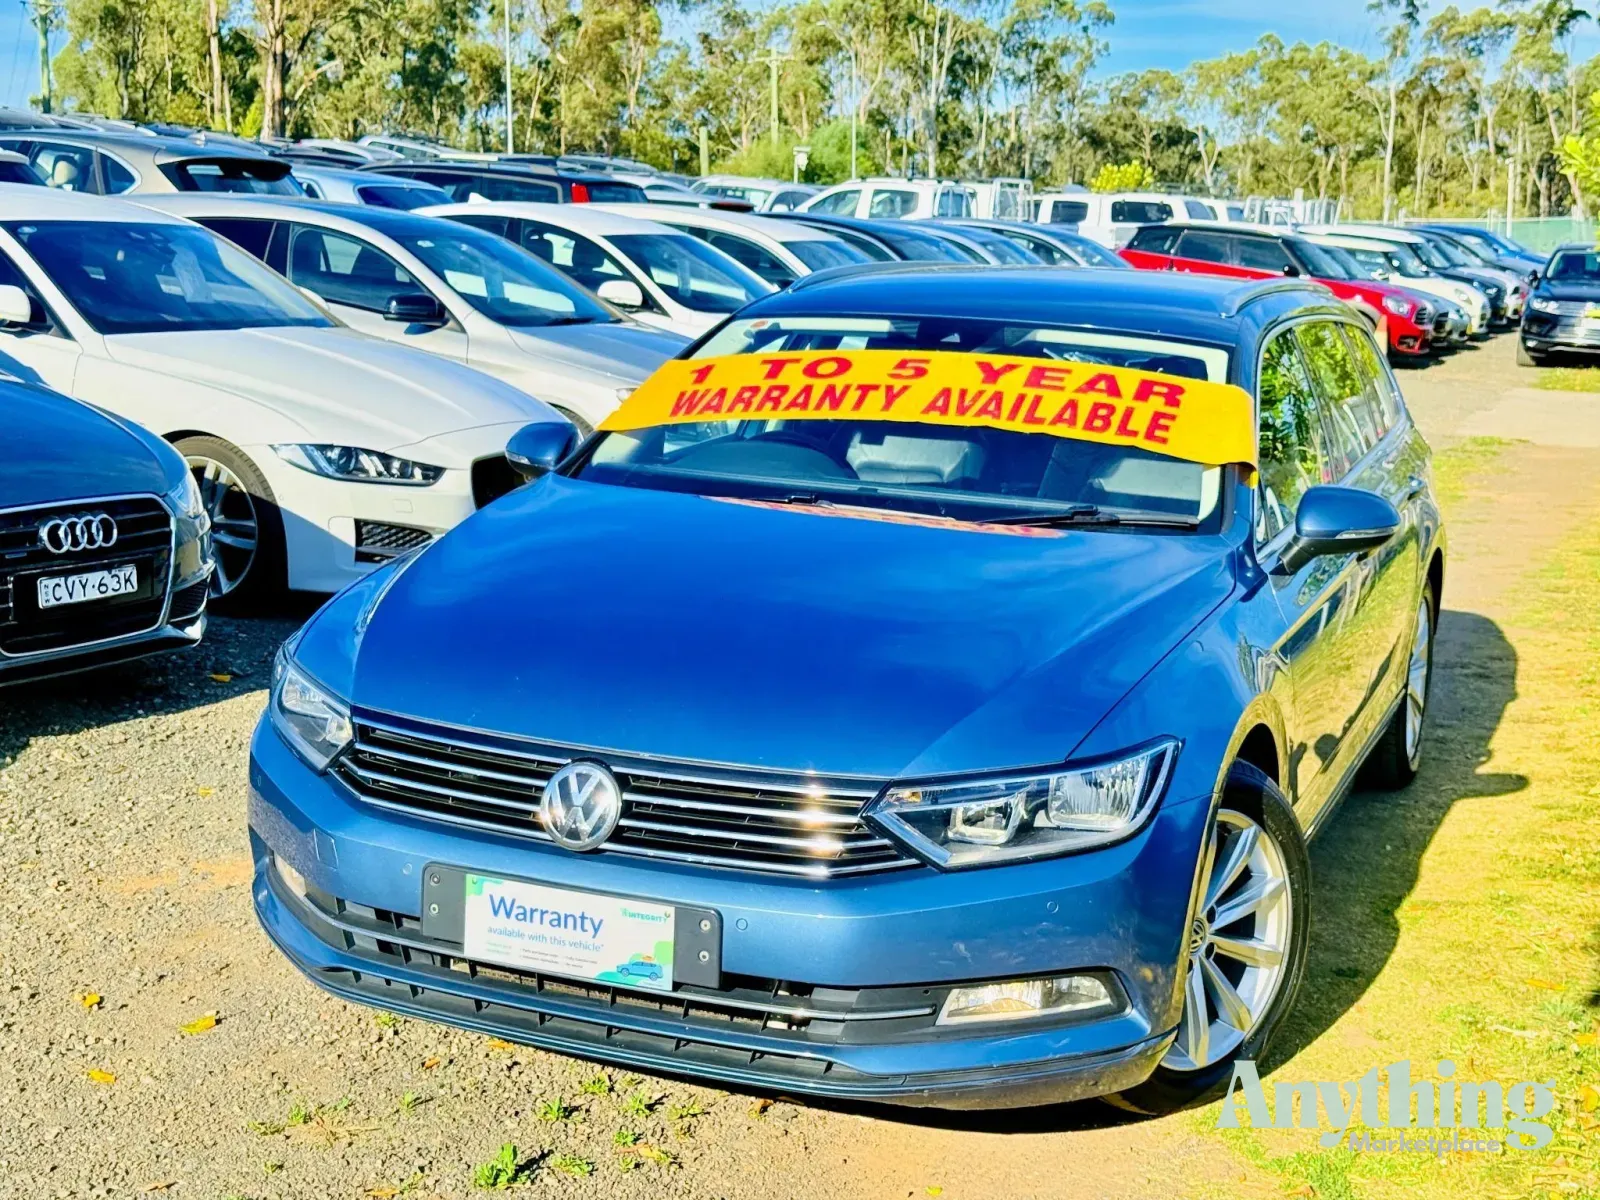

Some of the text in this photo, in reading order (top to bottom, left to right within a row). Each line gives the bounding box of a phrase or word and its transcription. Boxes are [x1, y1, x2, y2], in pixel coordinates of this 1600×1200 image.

[689, 356, 1187, 409] 1 TO 5 YEAR
[669, 383, 1178, 445] WARRANTY AVAILABLE
[487, 925, 526, 940] available
[528, 932, 548, 945] with
[549, 935, 566, 948] this
[488, 893, 604, 939] Warranty
